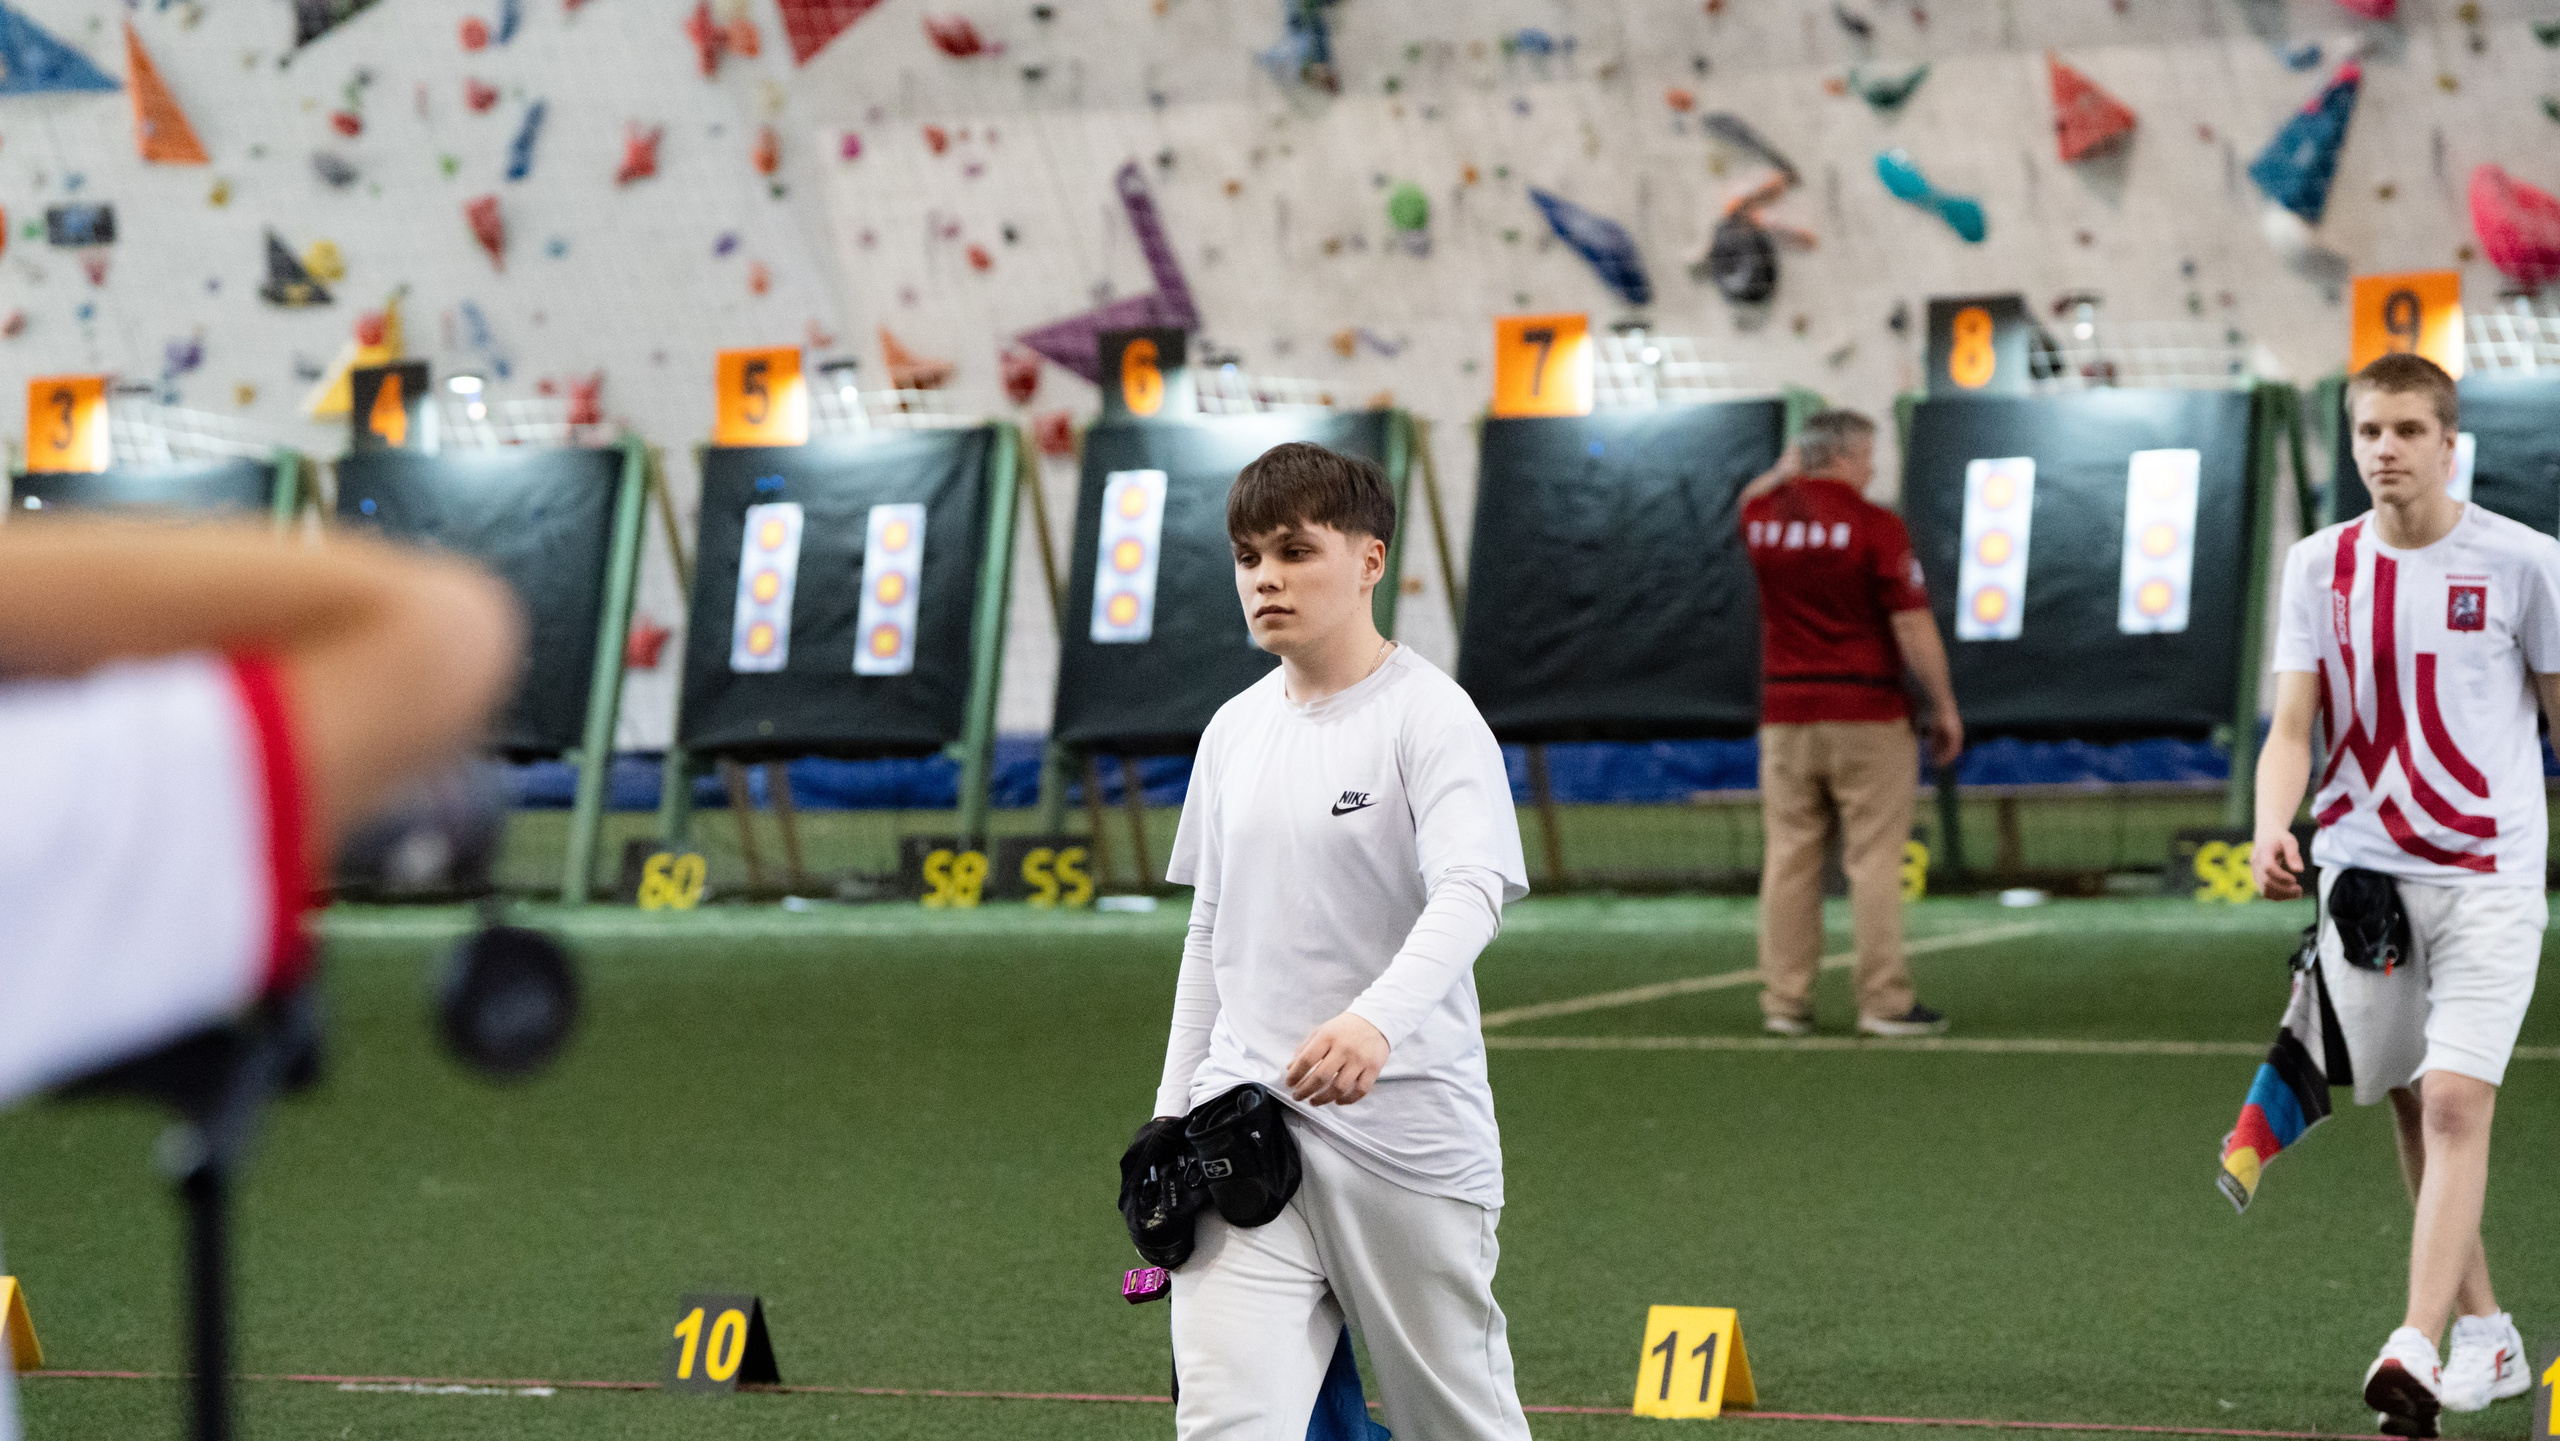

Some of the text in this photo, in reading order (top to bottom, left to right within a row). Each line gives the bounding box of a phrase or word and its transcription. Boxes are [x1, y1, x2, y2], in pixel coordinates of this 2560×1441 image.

[1950, 307, 1996, 388] 8
[2384, 287, 2421, 352] 9
[743, 358, 770, 425] 5
[1122, 337, 1164, 416] 6
[1523, 326, 1556, 397] 7
[50, 386, 75, 451] 3
[369, 373, 406, 448] 4
[1339, 790, 1370, 806] NIKE
[638, 852, 706, 911] 60
[673, 1307, 747, 1382] 10
[1652, 1330, 1718, 1403] 11
